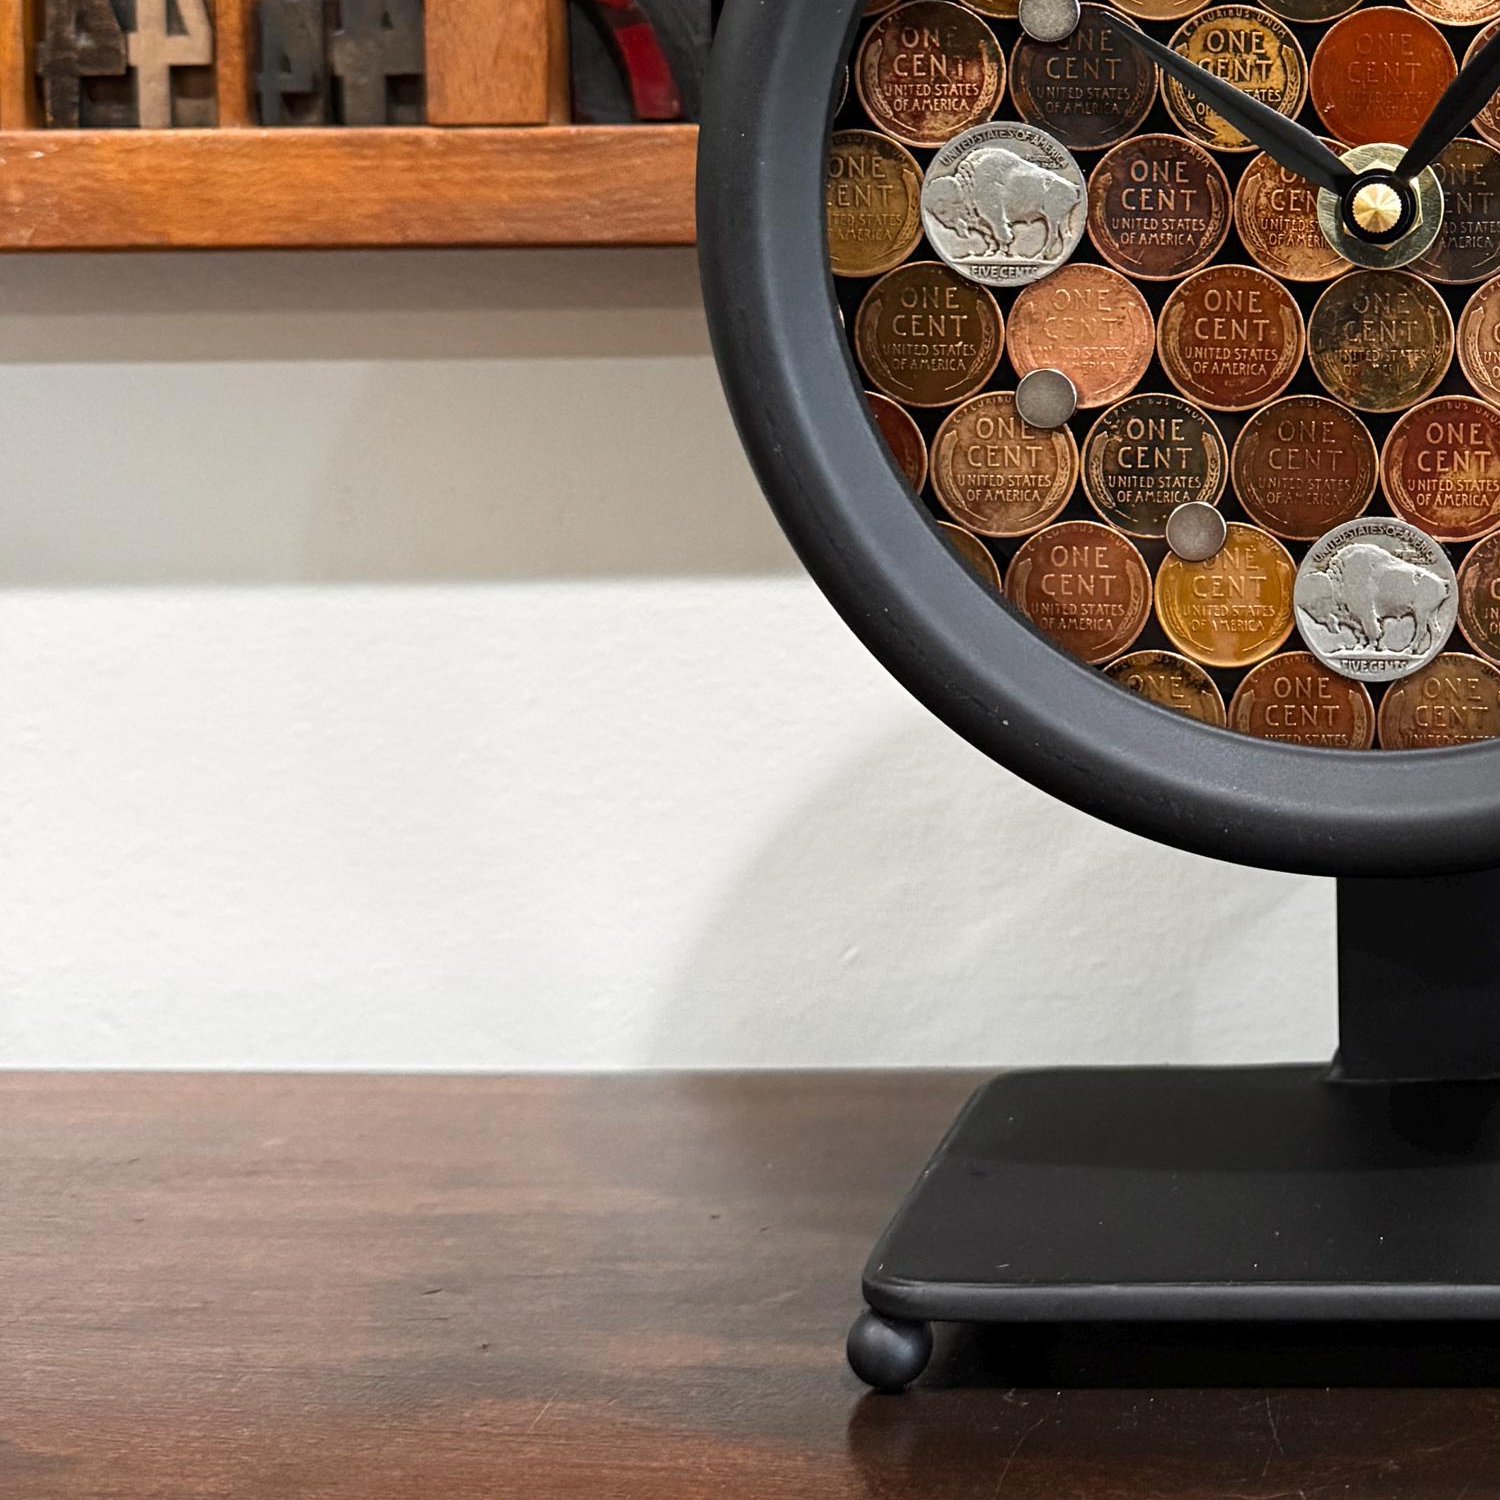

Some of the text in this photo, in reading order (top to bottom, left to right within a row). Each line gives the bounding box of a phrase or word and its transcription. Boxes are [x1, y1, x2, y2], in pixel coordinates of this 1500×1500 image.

[902, 25, 961, 49] ONE
[1206, 29, 1265, 53] ONE
[893, 54, 969, 78] CENT
[1046, 57, 1122, 81] CENT
[883, 83, 977, 97] UNITED STATES
[939, 136, 977, 166] UNITED
[974, 130, 1014, 145] STATES
[1014, 129, 1032, 142] OF
[1032, 134, 1070, 168] AMERICA
[1130, 159, 1189, 183] ONE
[1121, 188, 1197, 212] CENT
[1111, 217, 1205, 231] UNITED STATES
[1138, 232, 1194, 246] AMERICA
[971, 265, 1038, 278] FIVE CENTS
[901, 285, 960, 309] ONE
[1203, 289, 1262, 313] ONE
[1352, 290, 1411, 314] ONE
[892, 314, 968, 338] CENT
[1194, 318, 1270, 342] CENT
[1343, 319, 1419, 343] CENT
[882, 343, 976, 357] UNITED STATES
[1184, 347, 1278, 361] UNITED STATES
[1126, 417, 1185, 441] ONE
[1276, 419, 1335, 443] ONE
[1425, 421, 1484, 445] ONE
[967, 445, 1043, 469] CENT
[1117, 446, 1193, 470] CENT
[1267, 448, 1343, 472] CENT
[1416, 450, 1492, 474] CENT
[957, 474, 1051, 488] UNITED STATES
[1107, 475, 1201, 489] UNITED STATES
[1406, 479, 1500, 493] UNITED STATES
[984, 489, 1040, 503] AMERICA
[1134, 490, 1190, 504] AMERICA
[1345, 524, 1384, 540] STATES
[1050, 544, 1109, 568] ONE
[1041, 573, 1117, 597] CENT
[1192, 574, 1268, 598] CENT
[1341, 660, 1367, 672] FIVE
[1273, 675, 1332, 699] ONE
[1264, 704, 1340, 728] CENT
